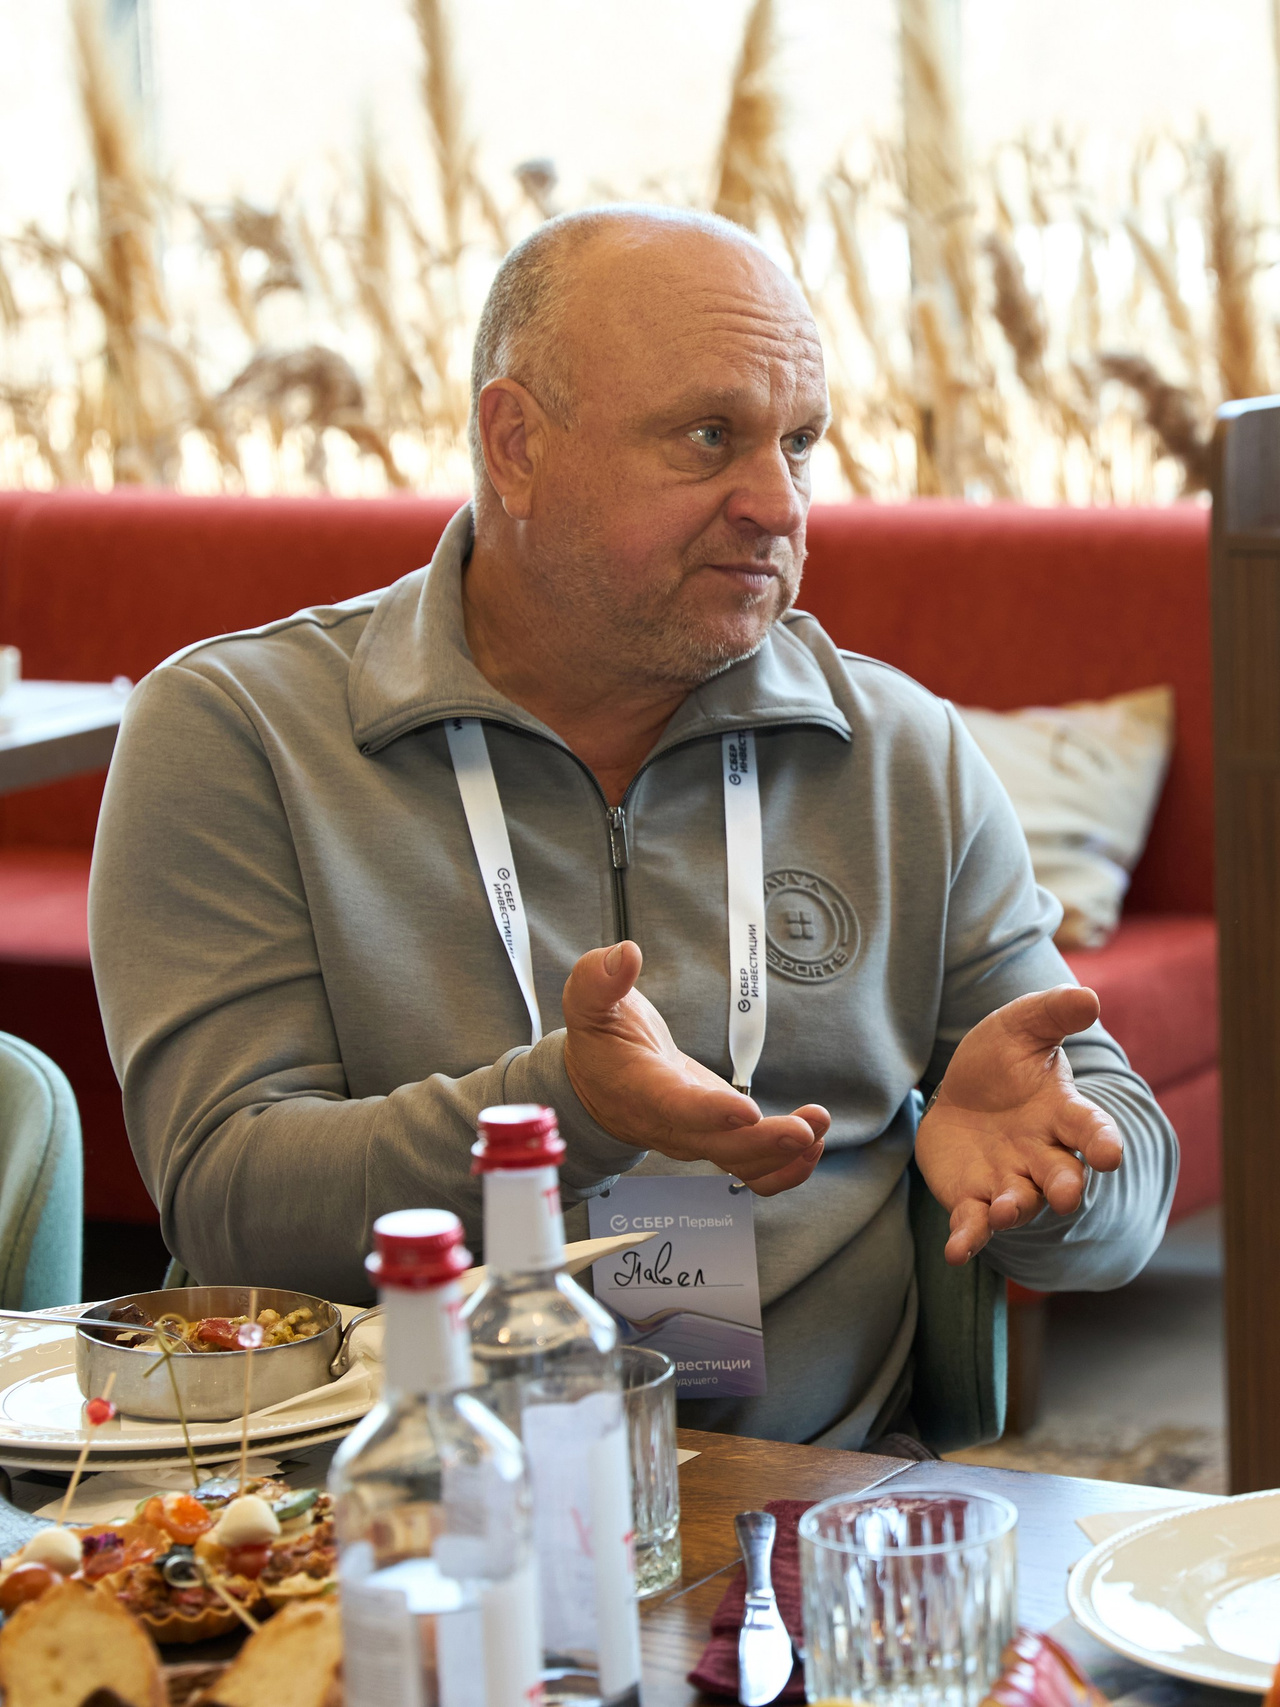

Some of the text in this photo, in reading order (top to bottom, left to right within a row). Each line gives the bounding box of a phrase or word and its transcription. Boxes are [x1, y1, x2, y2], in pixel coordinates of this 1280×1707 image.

[502, 883, 516, 912] СБЕР
[748, 924, 759, 998] ИНВЕСТИЦИИ
[766, 948, 849, 979] SPORTS
[740, 968, 749, 997] СБЕР
[632, 1214, 733, 1229] СБЕР Первый
[613, 1241, 706, 1287] Павел
[675, 1359, 751, 1372] вестиции
[676, 1377, 719, 1387] удущего
